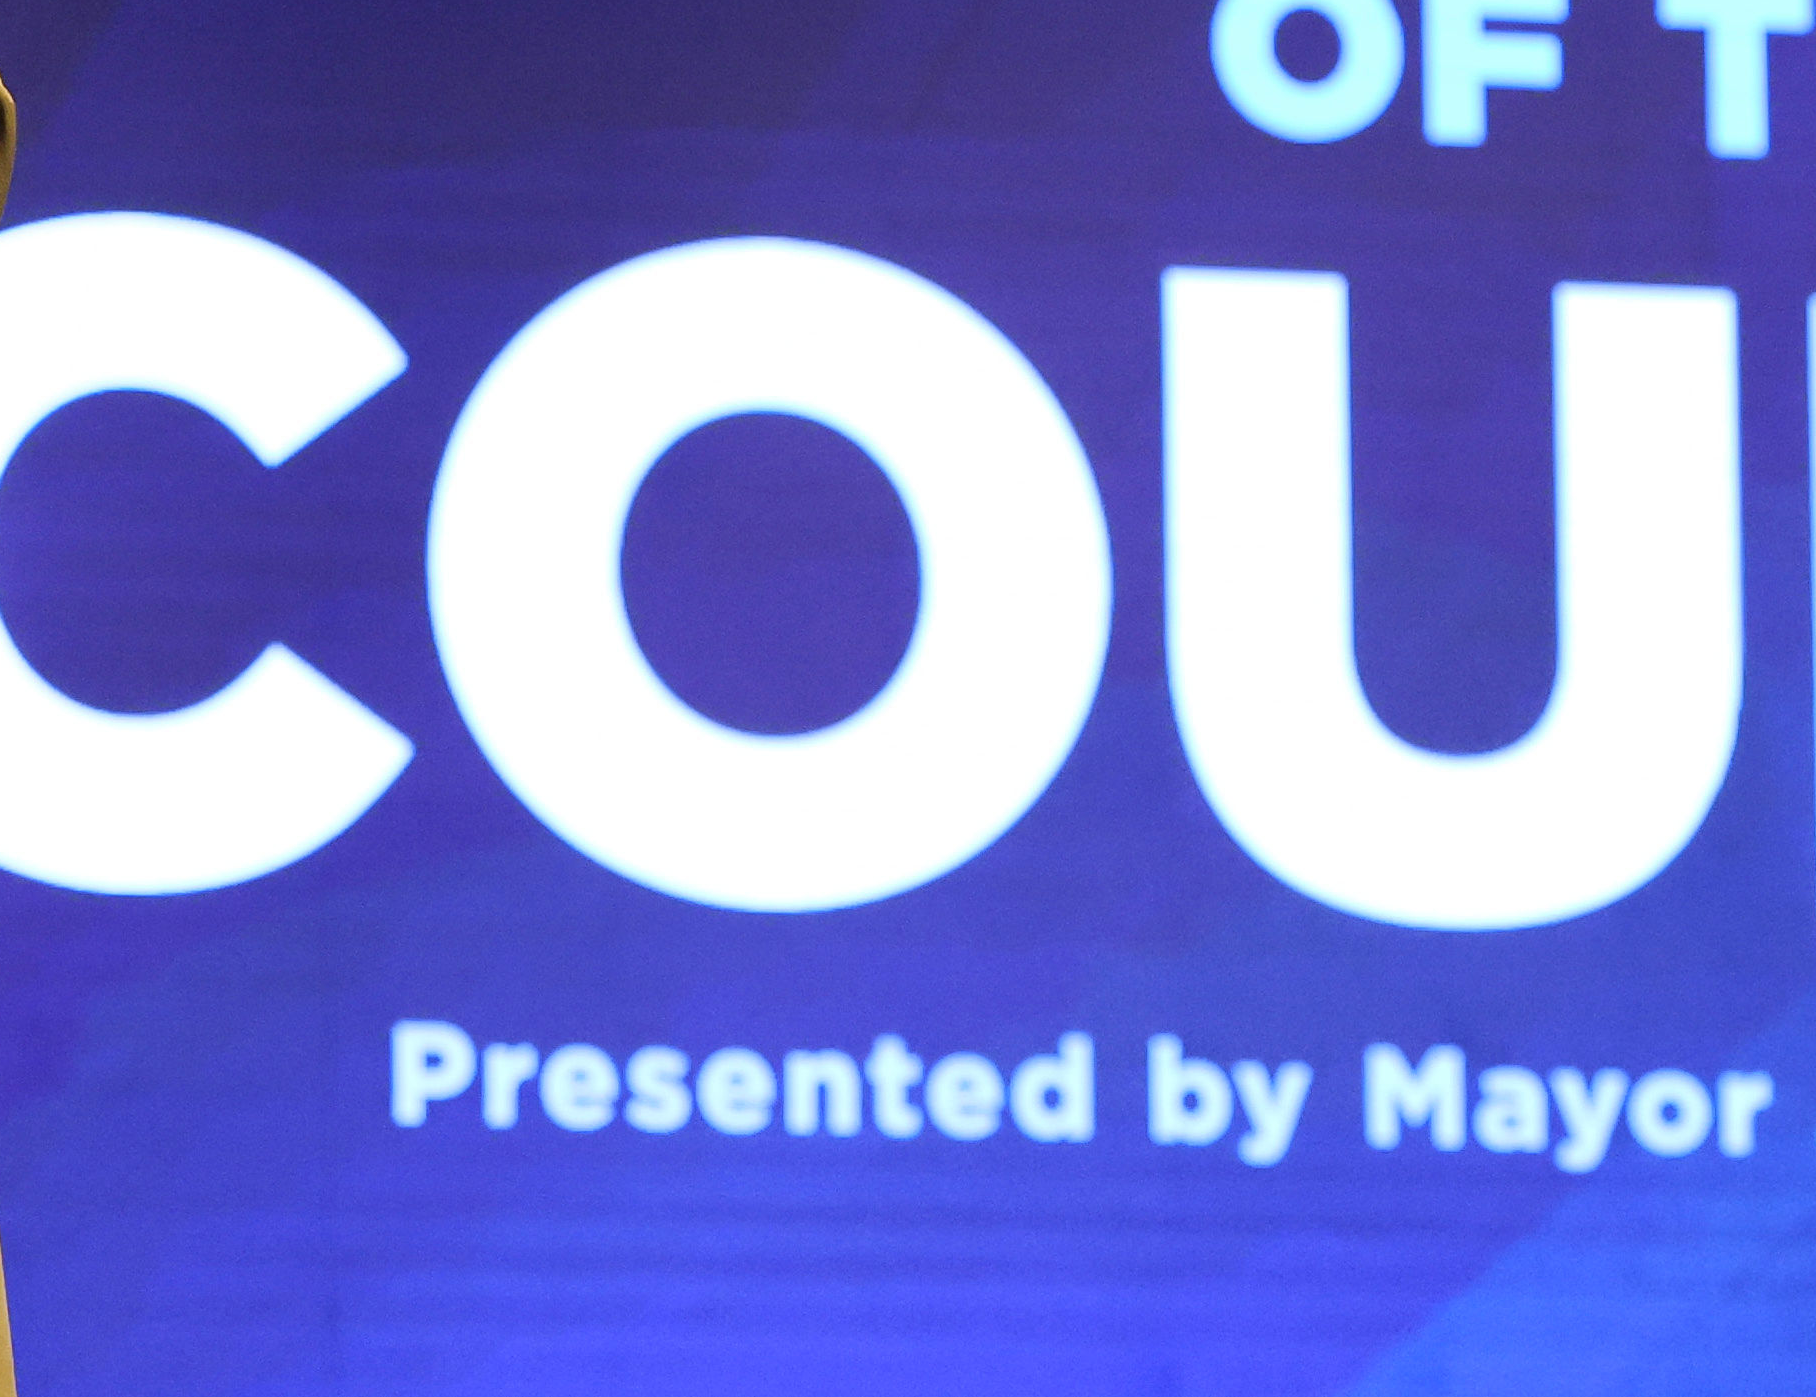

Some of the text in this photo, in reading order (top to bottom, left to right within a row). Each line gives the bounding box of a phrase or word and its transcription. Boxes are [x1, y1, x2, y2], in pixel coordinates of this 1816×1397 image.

[390, 1019, 1097, 1145] Presented
[1146, 1032, 1314, 1168] by
[1362, 1041, 1775, 1175] Mayor
